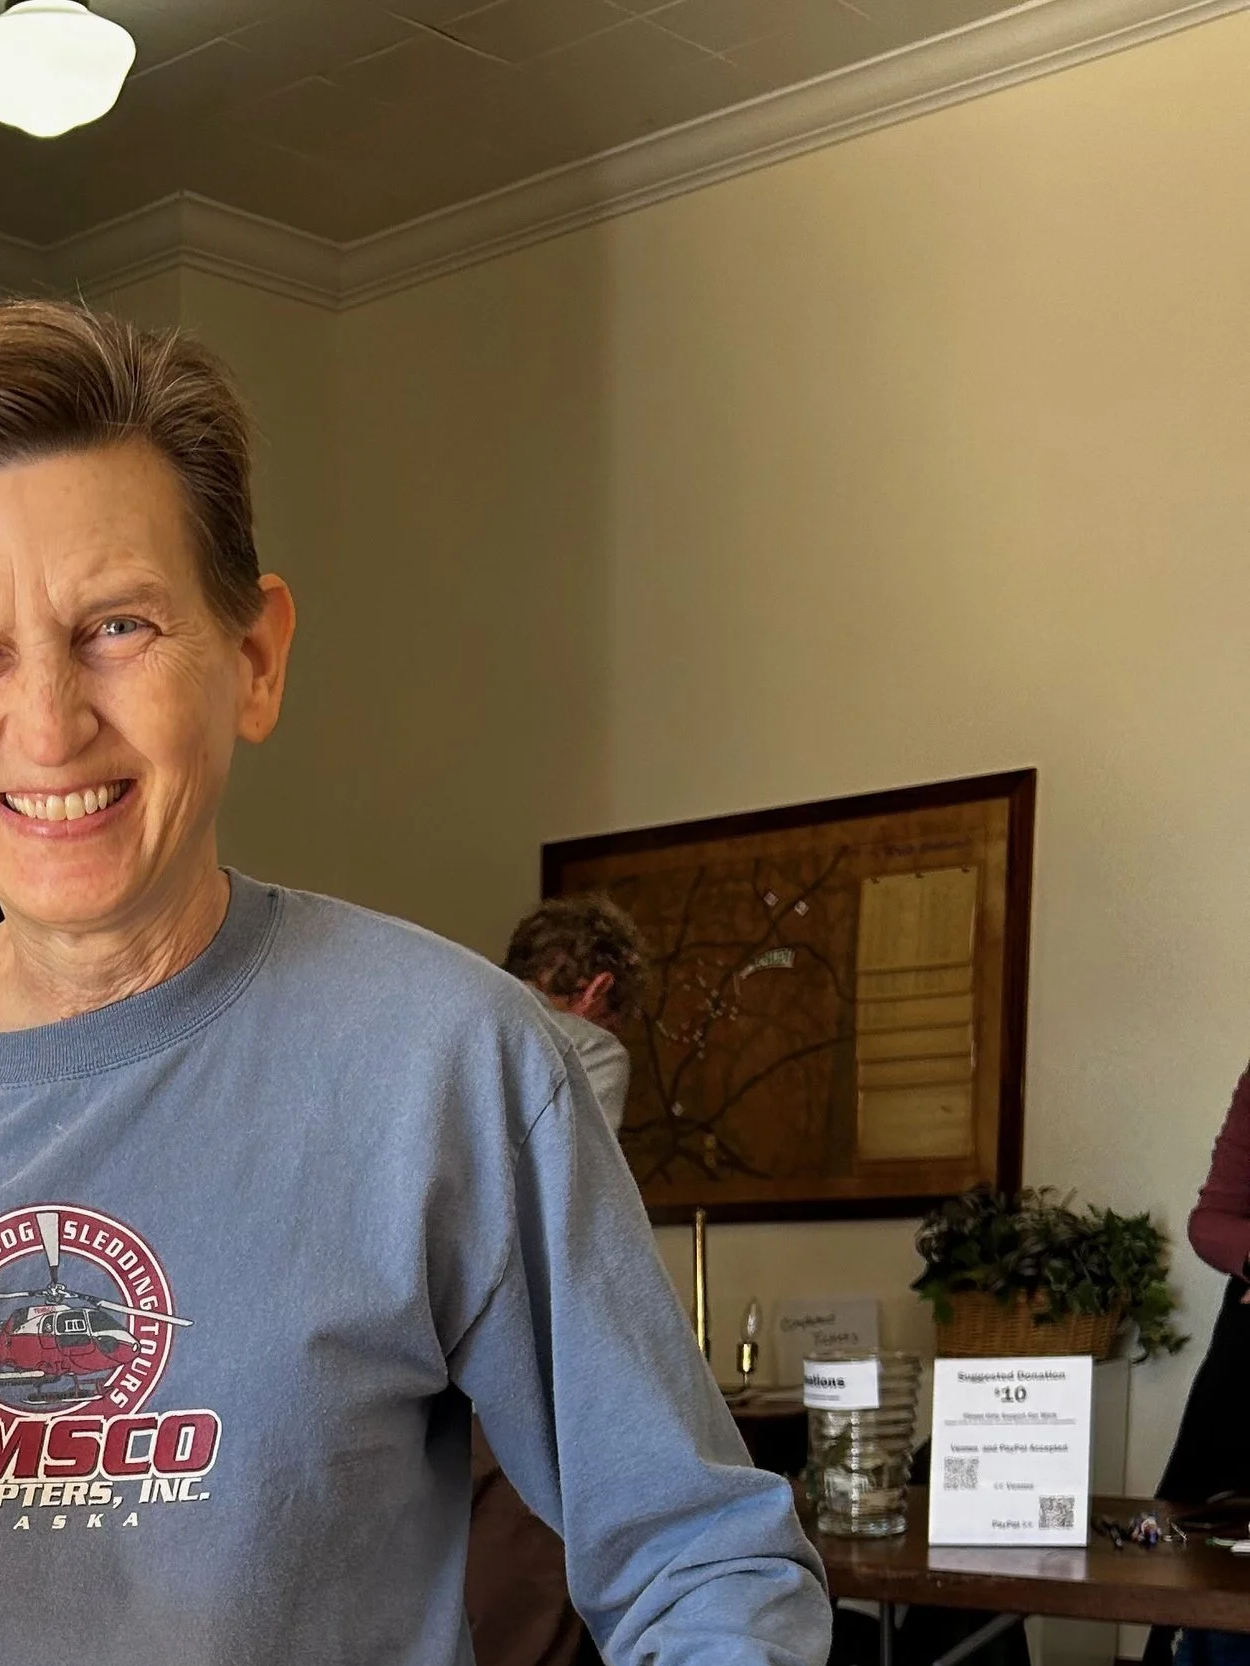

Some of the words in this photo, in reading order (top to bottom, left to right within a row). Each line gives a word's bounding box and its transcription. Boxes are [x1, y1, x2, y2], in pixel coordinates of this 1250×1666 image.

[63, 1220, 160, 1312] SLEDDING
[109, 1321, 160, 1410] TOURS
[957, 1370, 1015, 1384] Suggested
[1017, 1369, 1066, 1381] Donation
[994, 1385, 1028, 1403] $10
[138, 1478, 211, 1504] INC.
